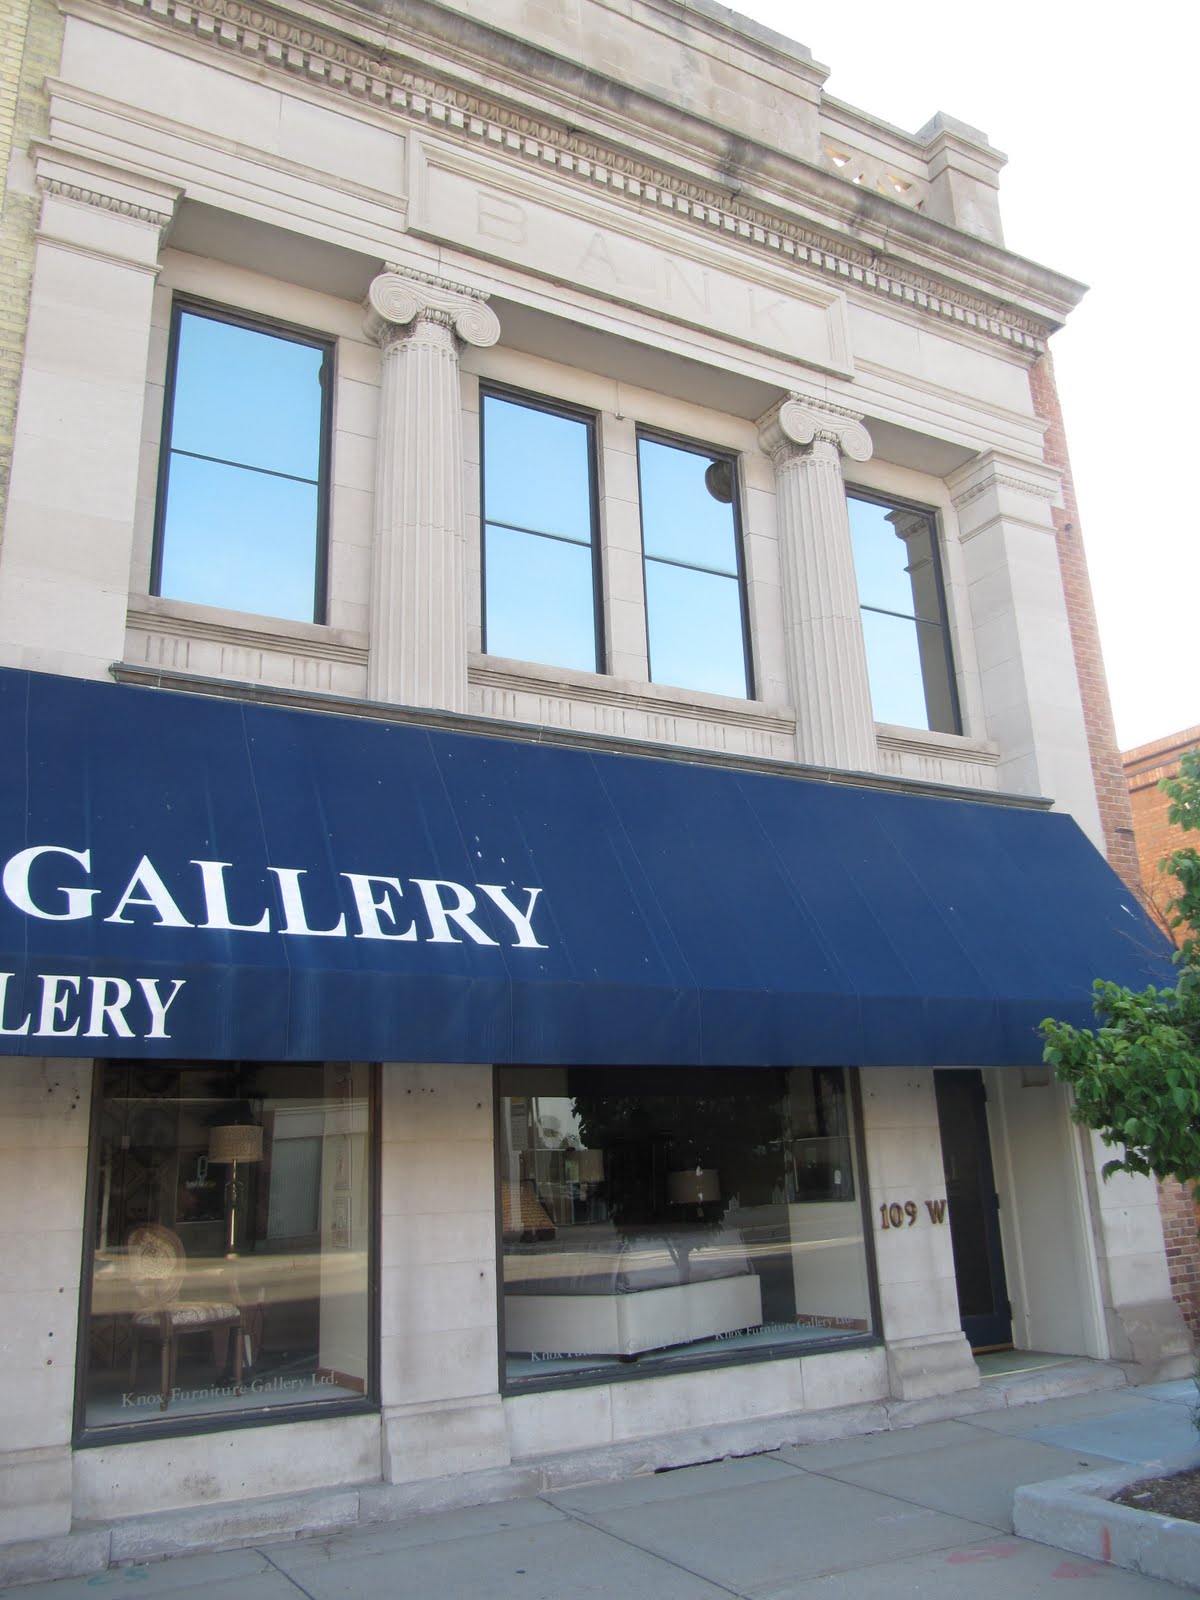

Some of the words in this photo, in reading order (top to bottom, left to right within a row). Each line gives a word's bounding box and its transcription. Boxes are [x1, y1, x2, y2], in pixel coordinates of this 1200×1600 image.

[476, 189, 794, 336] BANK
[2, 845, 549, 949] GALLERY
[0, 972, 187, 1038] LERY
[880, 1200, 918, 1229] 109
[924, 1199, 947, 1224] W
[746, 1321, 795, 1336] Furniture
[797, 1316, 834, 1329] Gallery
[121, 1393, 166, 1408] Knox
[171, 1383, 247, 1402] Furniture
[251, 1376, 305, 1393] Gallery
[312, 1370, 339, 1387] Ltd.
